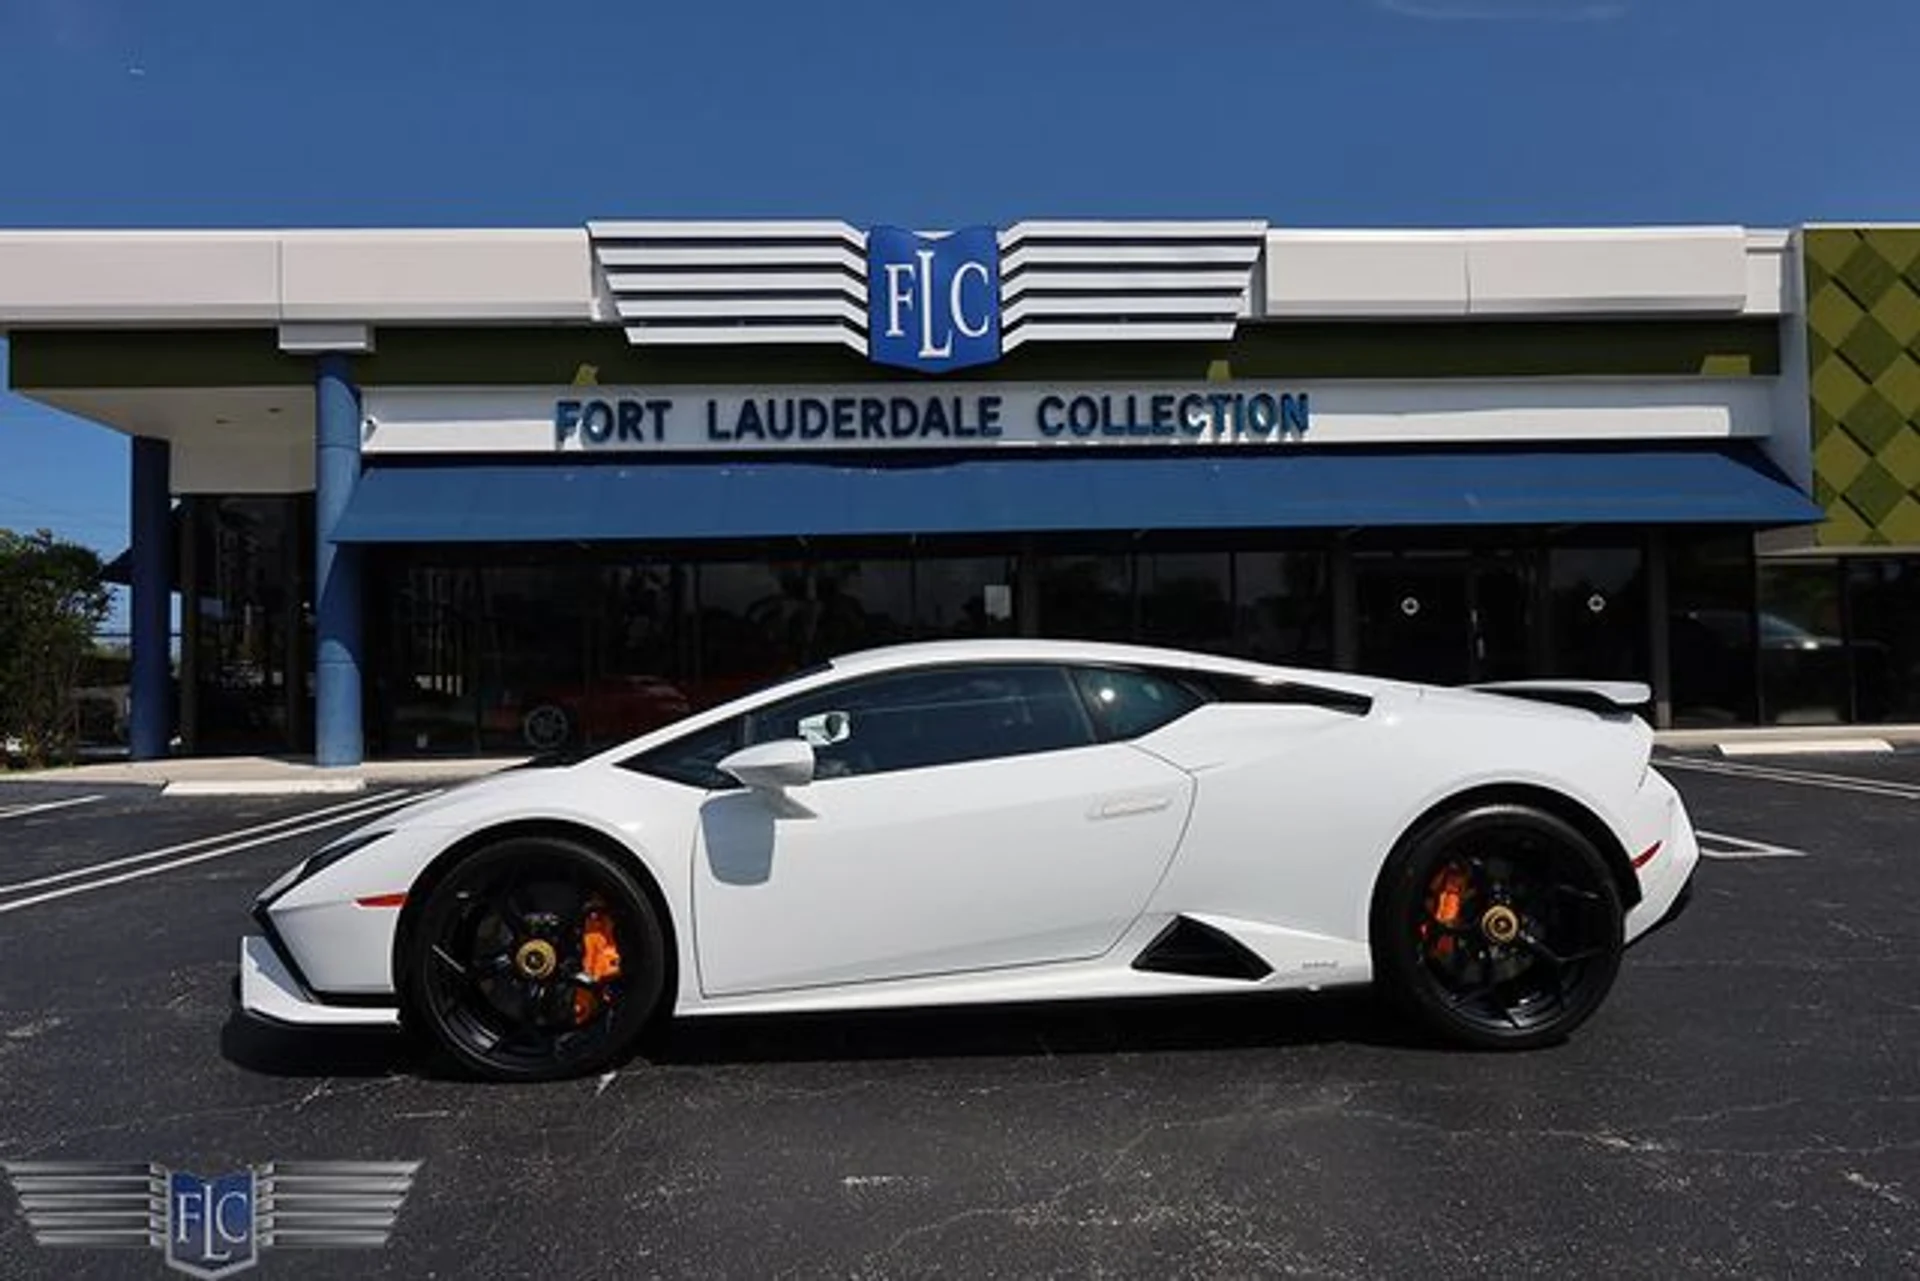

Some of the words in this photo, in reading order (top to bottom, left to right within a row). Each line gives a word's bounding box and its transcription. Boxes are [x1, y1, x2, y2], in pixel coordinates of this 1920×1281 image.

[884, 250, 989, 358] FLC
[555, 400, 672, 442] FORT
[707, 398, 1002, 440] LAUDERDALE
[1037, 393, 1309, 439] COLLECTION
